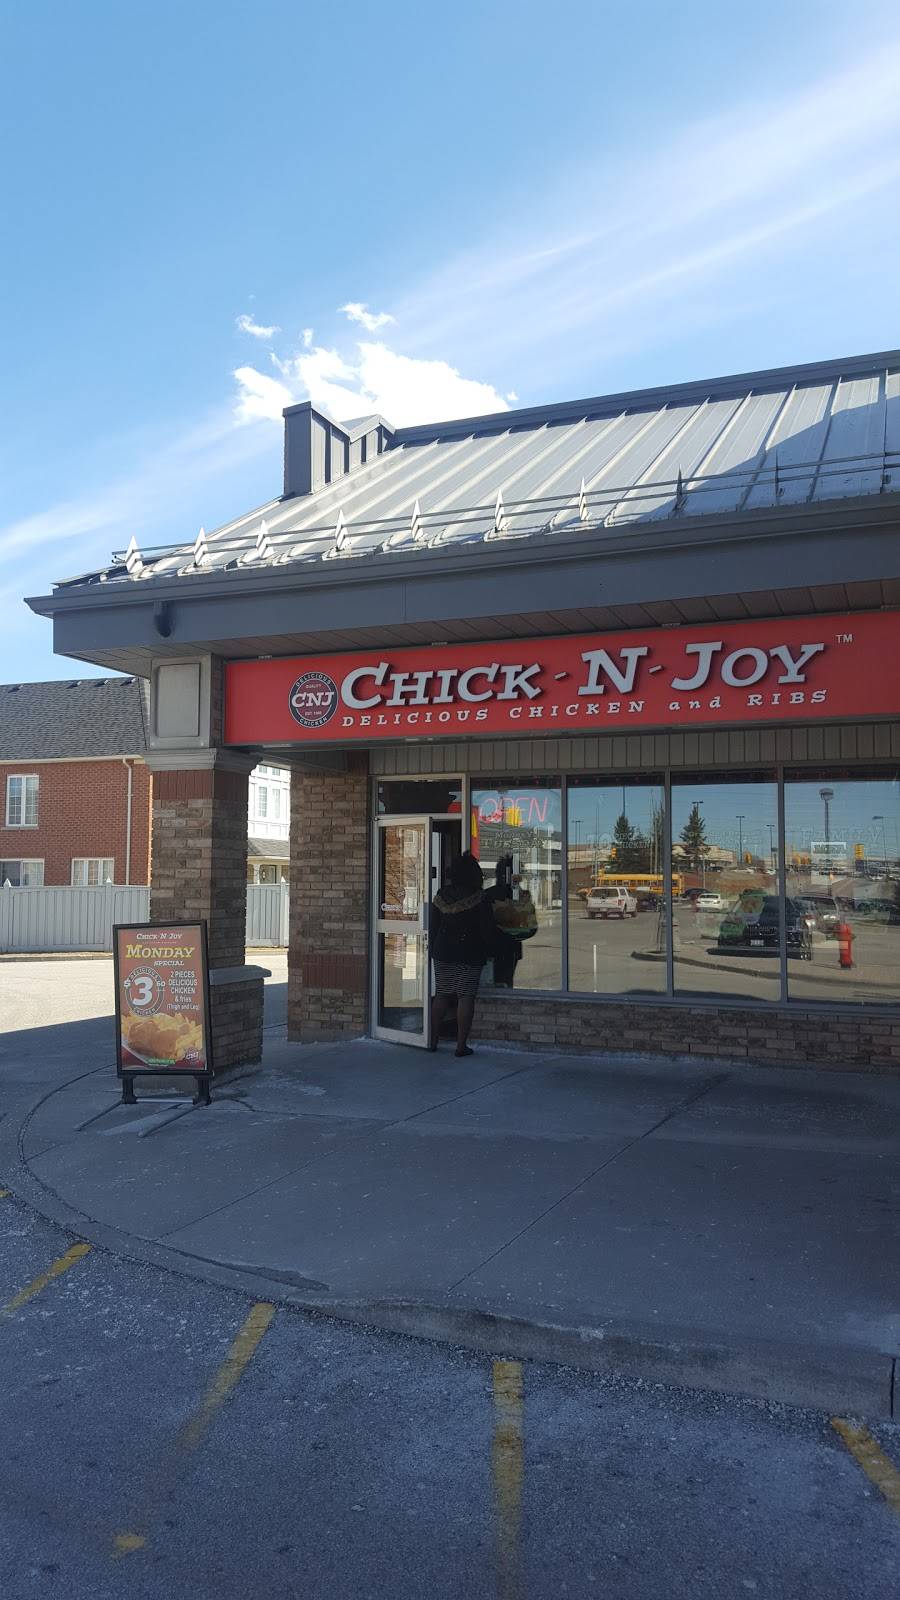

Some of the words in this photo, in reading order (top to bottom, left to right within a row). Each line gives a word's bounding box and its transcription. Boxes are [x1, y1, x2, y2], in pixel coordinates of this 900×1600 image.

[341, 662, 543, 710] CHICK
[671, 641, 825, 691] JOY
[291, 691, 335, 708] CNJ
[341, 708, 489, 727] DELICIOUS
[509, 700, 645, 719] CHICKEN
[668, 696, 721, 711] and
[747, 689, 828, 707] RIBS
[480, 797, 548, 826] OPEN
[126, 944, 195, 958] MONDAY
[175, 970, 195, 978] PIECES
[168, 978, 198, 986] DELICIOUS
[170, 986, 196, 994] CHICKEN
